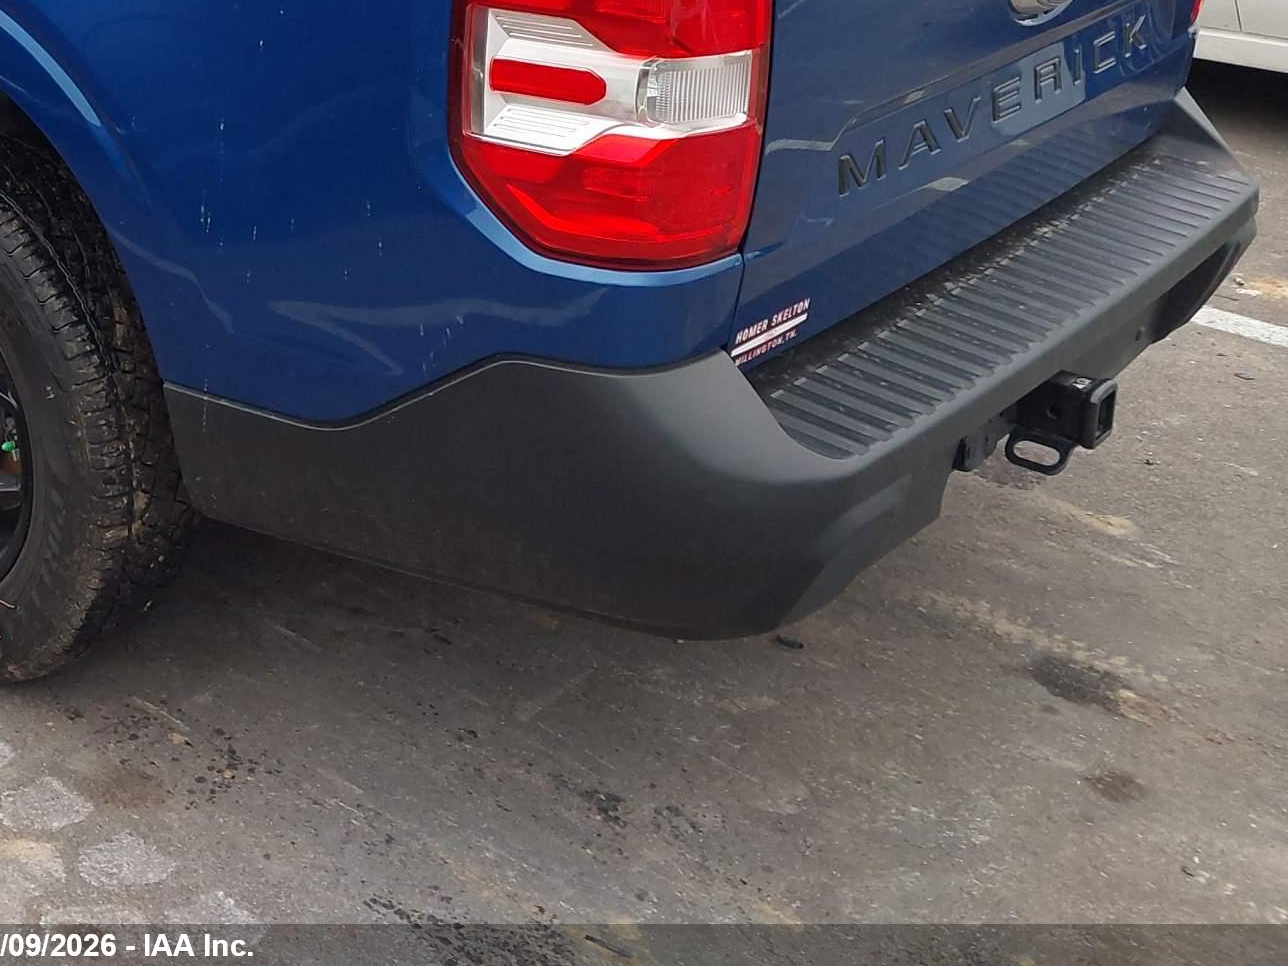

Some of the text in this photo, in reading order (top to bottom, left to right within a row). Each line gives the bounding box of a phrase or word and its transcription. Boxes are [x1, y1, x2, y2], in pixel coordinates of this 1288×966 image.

[839, 14, 1147, 197] MAVERICK
[735, 298, 811, 345] HOMER SKELTON
